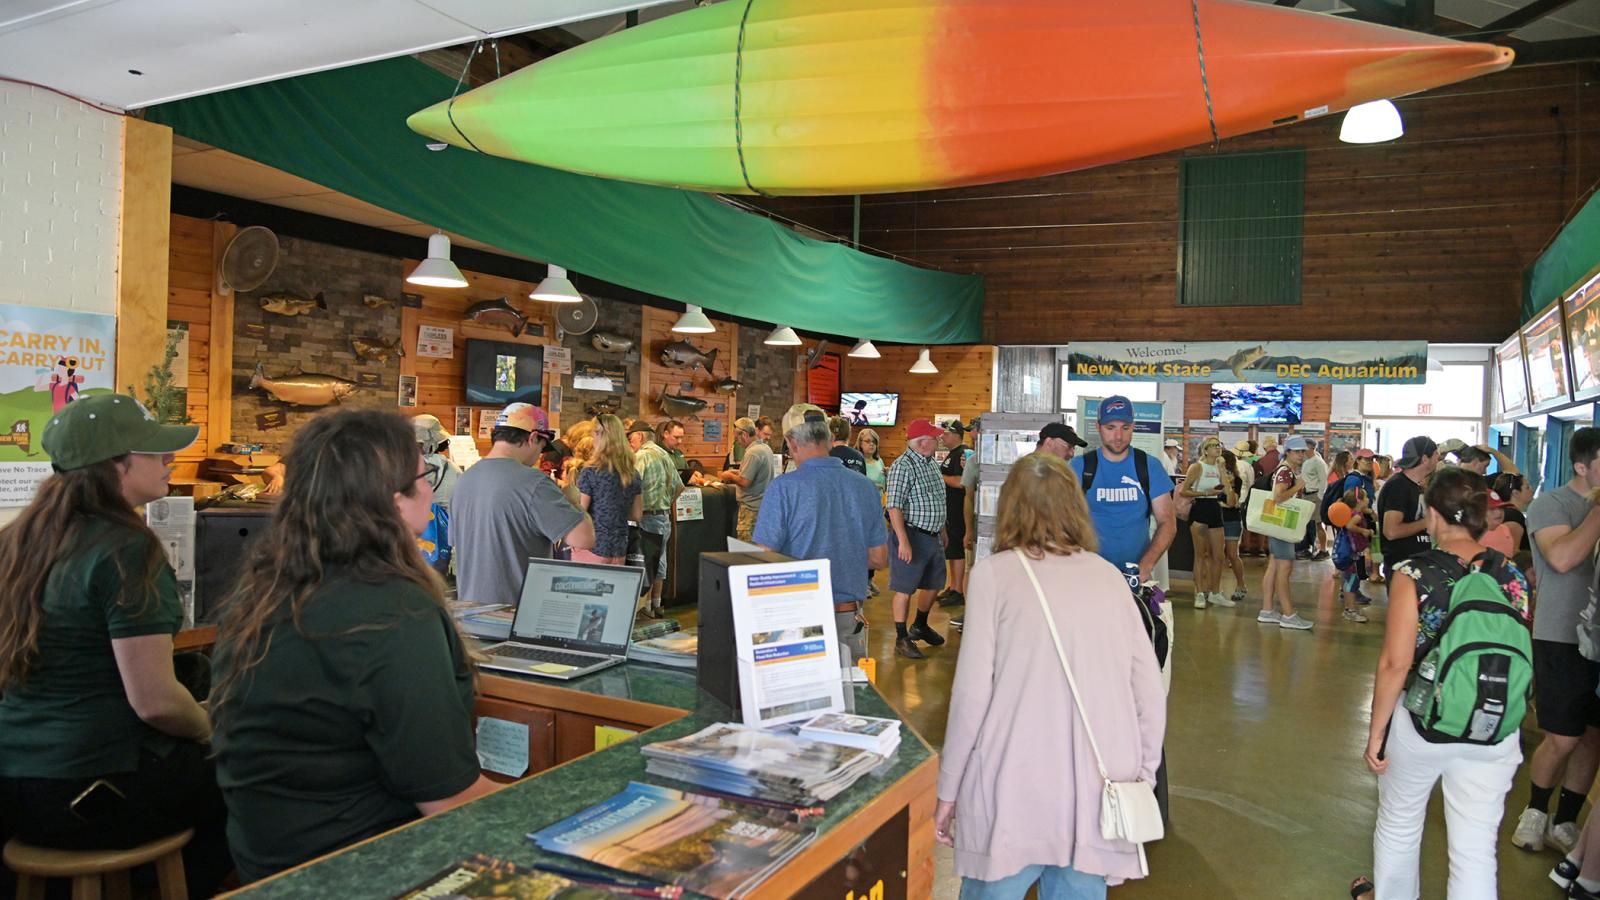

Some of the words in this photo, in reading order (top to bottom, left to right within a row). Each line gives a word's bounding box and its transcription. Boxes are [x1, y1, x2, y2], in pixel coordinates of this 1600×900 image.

[79, 337, 106, 356] IN,
[1126, 345, 1188, 358] Welcome!
[1076, 363, 1113, 376] New
[1119, 363, 1157, 377] York
[1163, 363, 1212, 377] State
[1276, 364, 1311, 378] DEC
[1317, 363, 1418, 380] Aquarium
[1417, 403, 1433, 415] EXIT
[1097, 487, 1138, 502] PUMA
